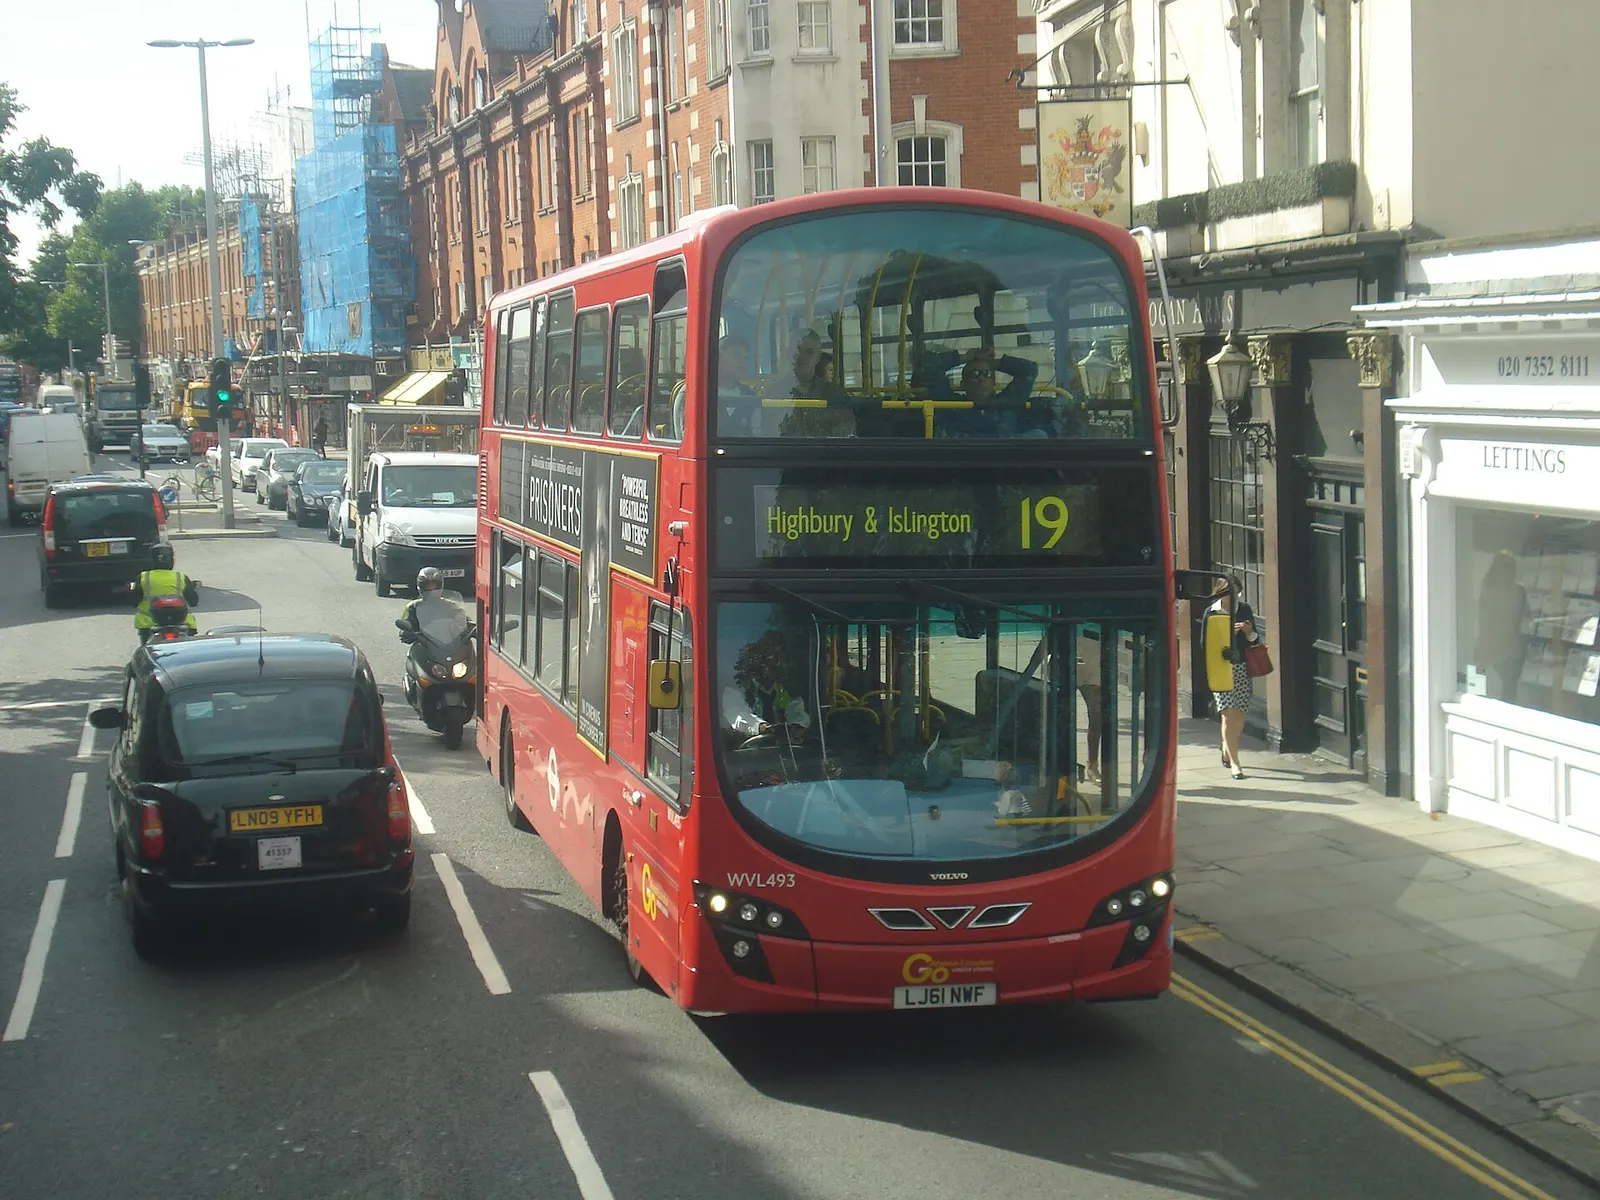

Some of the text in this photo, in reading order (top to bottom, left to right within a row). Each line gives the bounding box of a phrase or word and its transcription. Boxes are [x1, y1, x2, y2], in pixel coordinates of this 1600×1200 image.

[1192, 292, 1233, 323] ARMS
[1499, 355, 1589, 377] 020 7352 8111
[1484, 445, 1566, 474] LETTINGS
[529, 475, 581, 536] PRISONERS
[621, 521, 632, 542] AND
[767, 506, 972, 541] Highbury & Islington
[1021, 496, 1069, 549] 19
[235, 807, 315, 827] LN09 YFH
[726, 872, 796, 889] WVL493
[929, 873, 969, 881] VOLVO
[902, 952, 950, 984] Go
[904, 985, 985, 1006] LJ61 NWF
